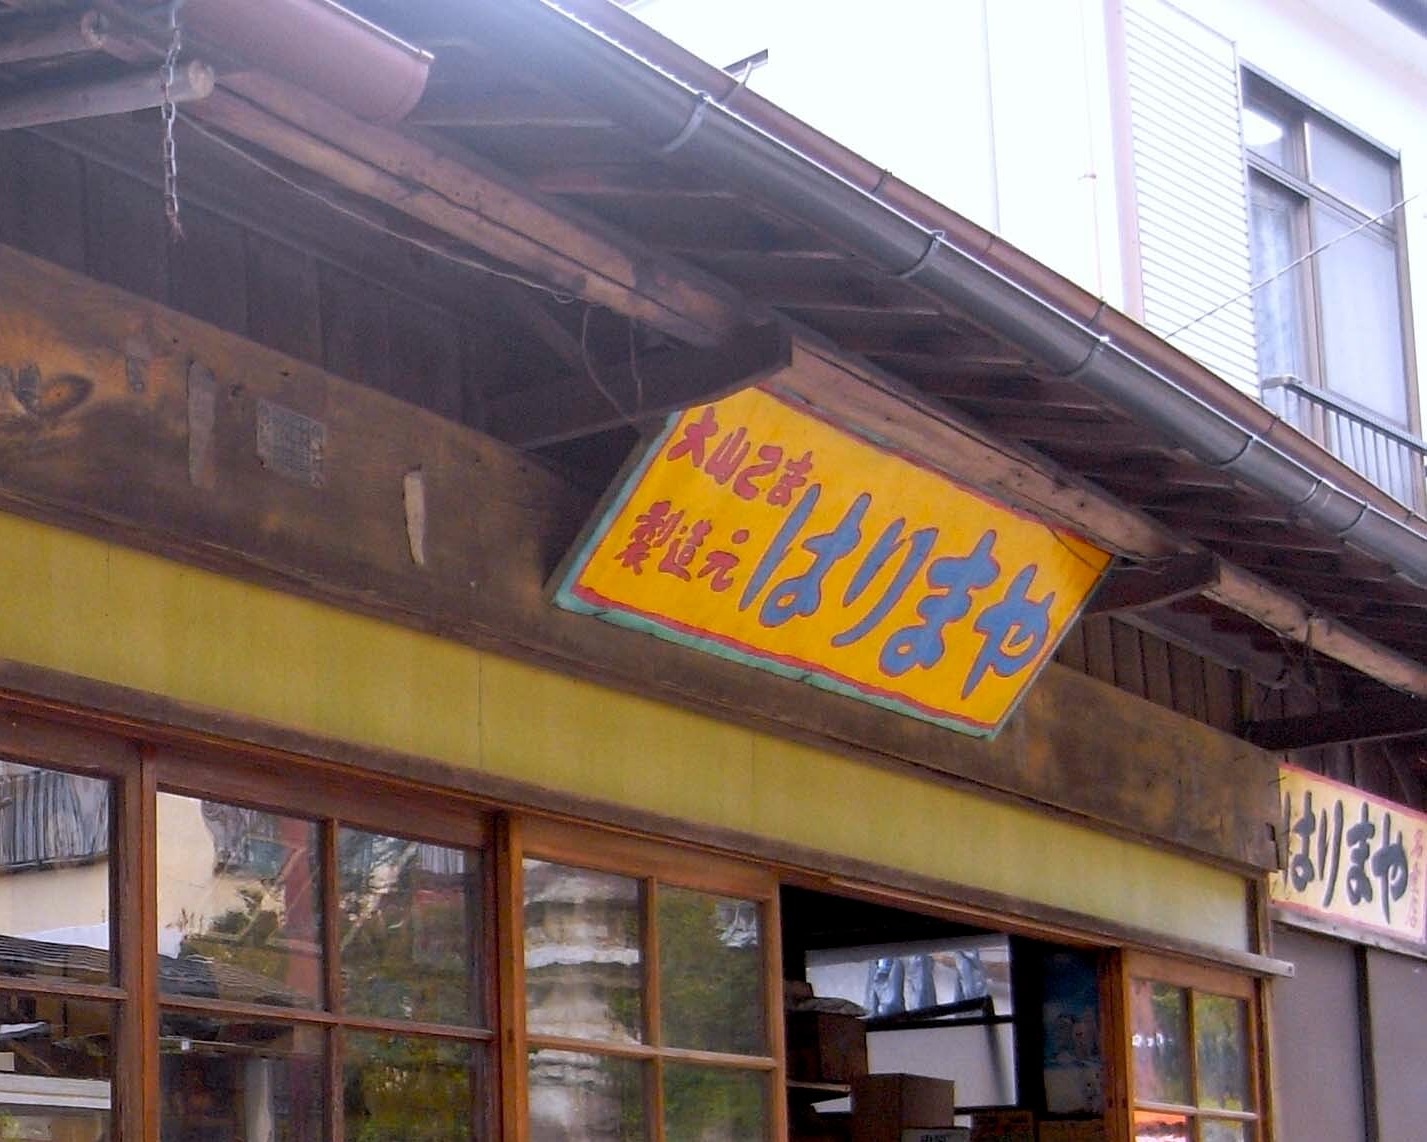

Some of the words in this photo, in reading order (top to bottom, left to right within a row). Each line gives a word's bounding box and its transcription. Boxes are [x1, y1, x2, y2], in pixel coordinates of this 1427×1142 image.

[667, 405, 818, 507] 大山こま
[614, 499, 751, 592] 製造元
[738, 482, 1056, 700] はりまや
[1282, 790, 1410, 925] はりまや
